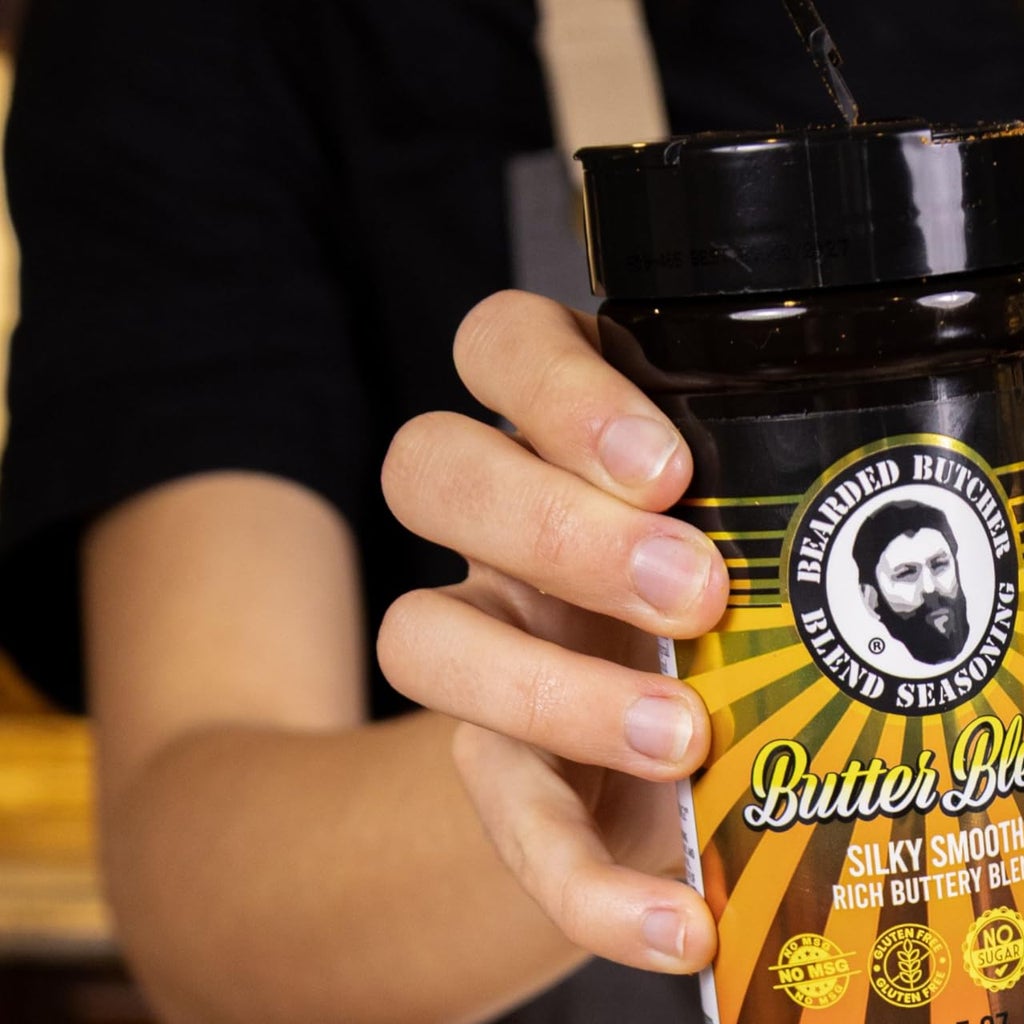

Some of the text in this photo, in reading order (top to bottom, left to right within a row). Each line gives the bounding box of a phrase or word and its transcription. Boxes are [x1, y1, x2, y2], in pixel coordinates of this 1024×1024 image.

[797, 459, 900, 584] BEARDED
[913, 455, 1011, 559] BUTCHER
[801, 608, 885, 699] BLEND
[896, 583, 1015, 708] SEASONING
[743, 738, 938, 831] Butter
[847, 816, 1024, 877] SILKY SMOOTH
[832, 881, 884, 910] RICH
[891, 867, 981, 906] BUTTERY
[784, 937, 832, 959] NO MSG
[874, 928, 943, 960] GLUTEN FREE
[982, 924, 1014, 949] NO
[778, 958, 850, 983] NO MSG
[978, 944, 1020, 966] SUGAR
[794, 985, 844, 1005] NO MSG
[876, 970, 946, 1004] GLUTEN FREE
